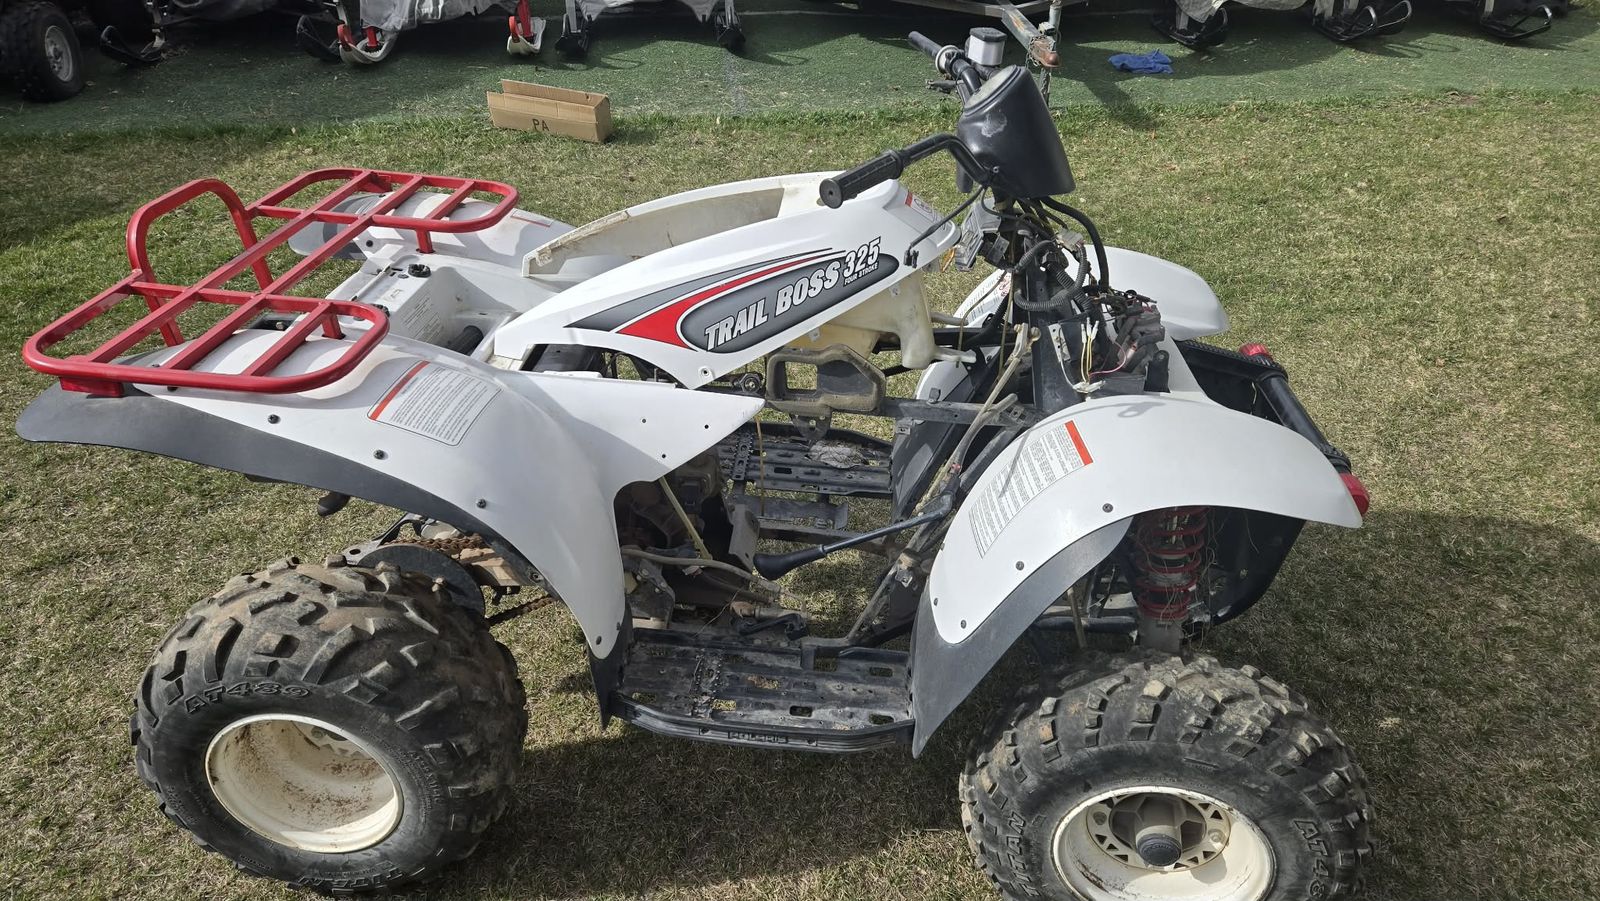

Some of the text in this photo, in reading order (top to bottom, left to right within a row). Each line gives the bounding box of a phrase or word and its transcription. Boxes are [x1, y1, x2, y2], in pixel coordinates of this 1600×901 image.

[704, 236, 881, 351] TRAIL BOSS 325
[843, 262, 879, 287] FOUR STROKE
[185, 681, 312, 713] AT489
[1007, 810, 1041, 897] TITAN
